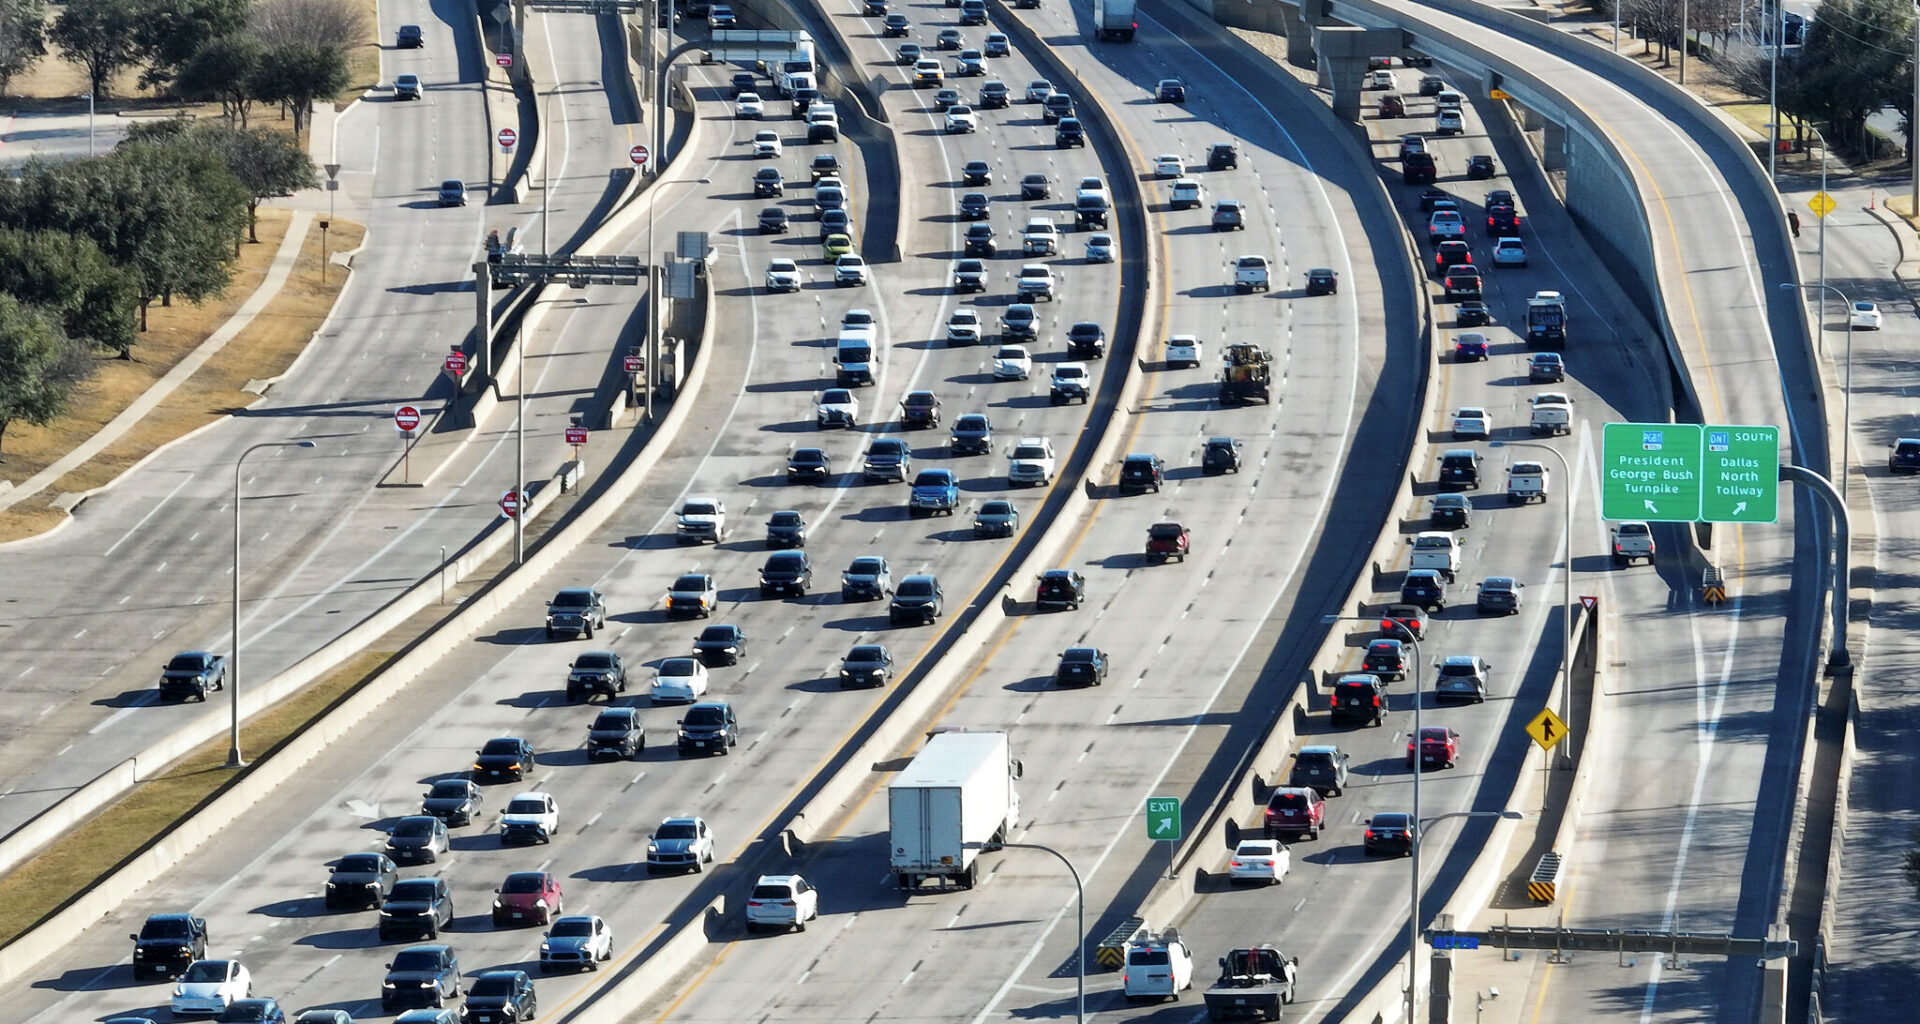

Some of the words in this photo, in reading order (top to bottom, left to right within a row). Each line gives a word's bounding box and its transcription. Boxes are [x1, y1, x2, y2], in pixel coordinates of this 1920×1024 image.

[1643, 432, 1662, 443] PGBT
[1710, 434, 1727, 444] DNT
[1735, 432, 1773, 442] SOUTH
[1619, 455, 1685, 466] President
[1720, 457, 1759, 468] Dallas
[1610, 469, 1656, 481] George
[1663, 469, 1693, 480] Bush
[1720, 471, 1759, 481] North
[1624, 483, 1679, 495] Turnpike
[1715, 485, 1764, 498] Tollway
[1150, 802, 1175, 812] EXIT
